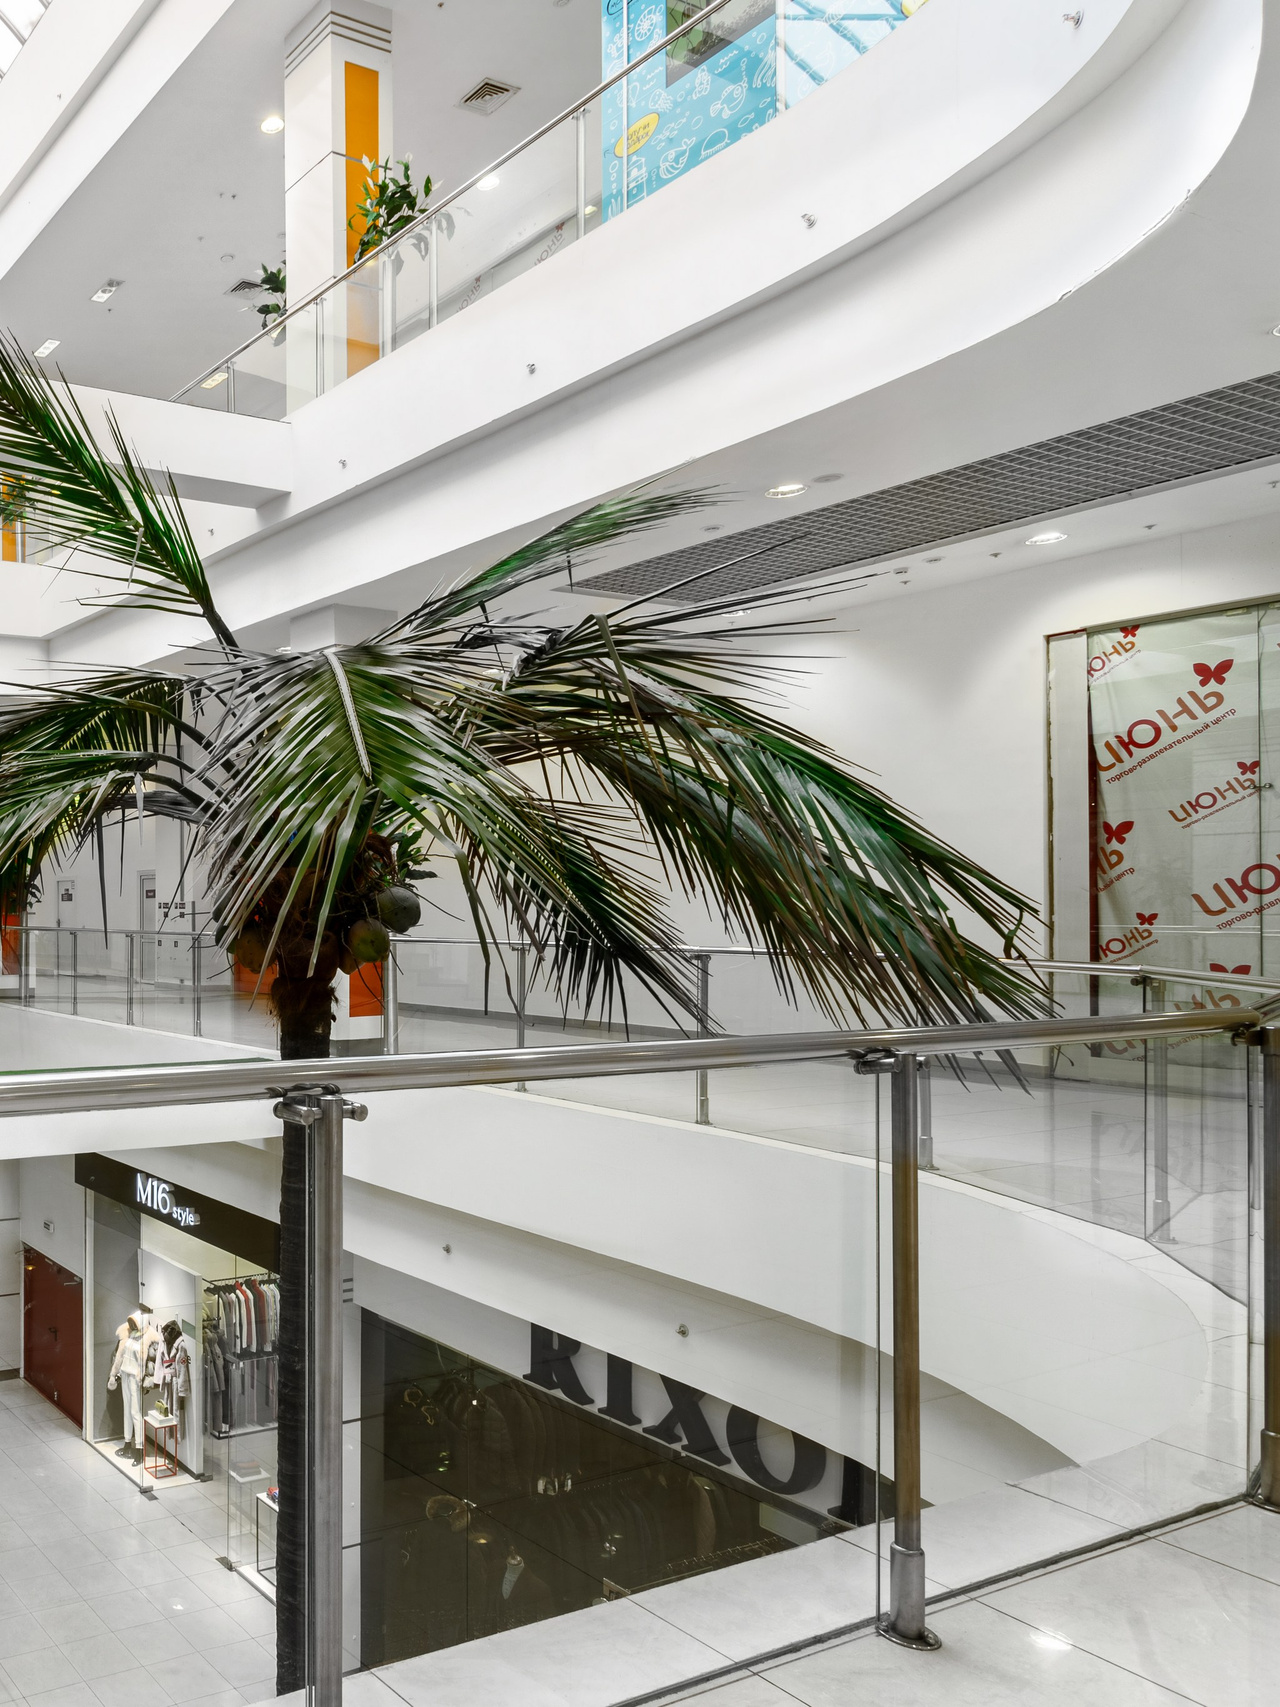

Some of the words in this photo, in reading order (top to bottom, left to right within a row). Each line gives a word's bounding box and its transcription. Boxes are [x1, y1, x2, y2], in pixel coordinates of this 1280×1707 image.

[534, 233, 563, 266] ЮНЬ
[1087, 641, 1136, 678] ЮНЬ
[1106, 722, 1211, 785] торгово-развлекательный
[1211, 708, 1237, 726] центр
[1114, 867, 1136, 882] центр
[1191, 852, 1280, 917] ИЮ
[1216, 898, 1280, 930] торгово-развл
[1099, 927, 1153, 961] ЮНЬ
[136, 1172, 171, 1214] M16
[172, 1206, 195, 1226] style
